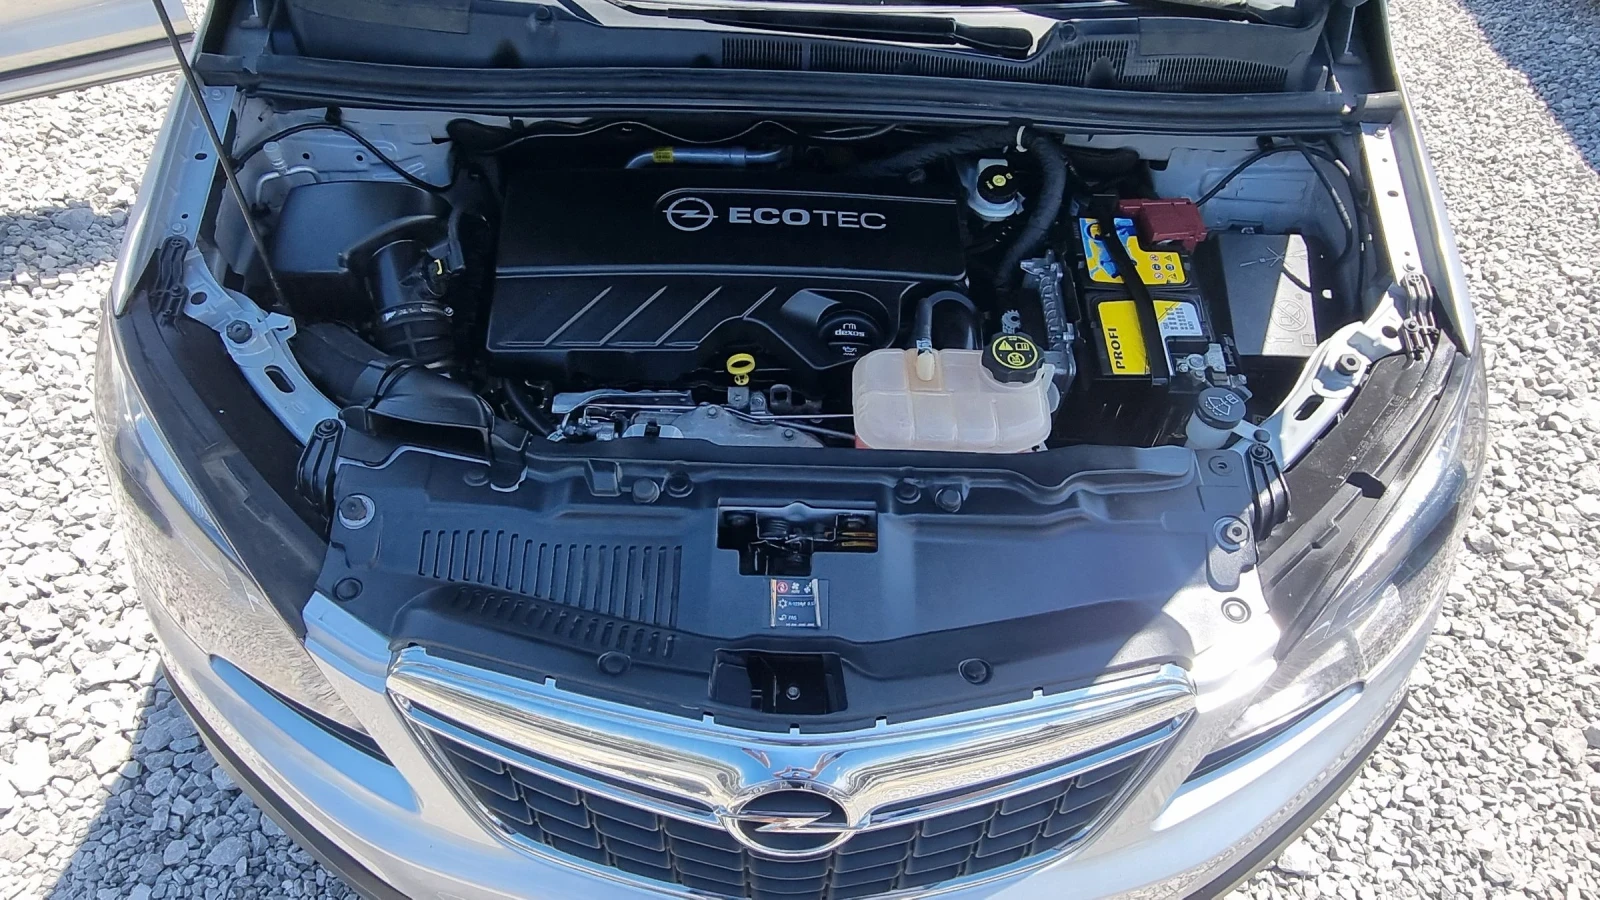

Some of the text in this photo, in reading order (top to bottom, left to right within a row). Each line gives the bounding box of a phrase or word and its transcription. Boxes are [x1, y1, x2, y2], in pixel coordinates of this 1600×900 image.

[729, 207, 887, 230] ECOTEC
[834, 329, 865, 337] dexos
[1108, 328, 1126, 369] PROFI
